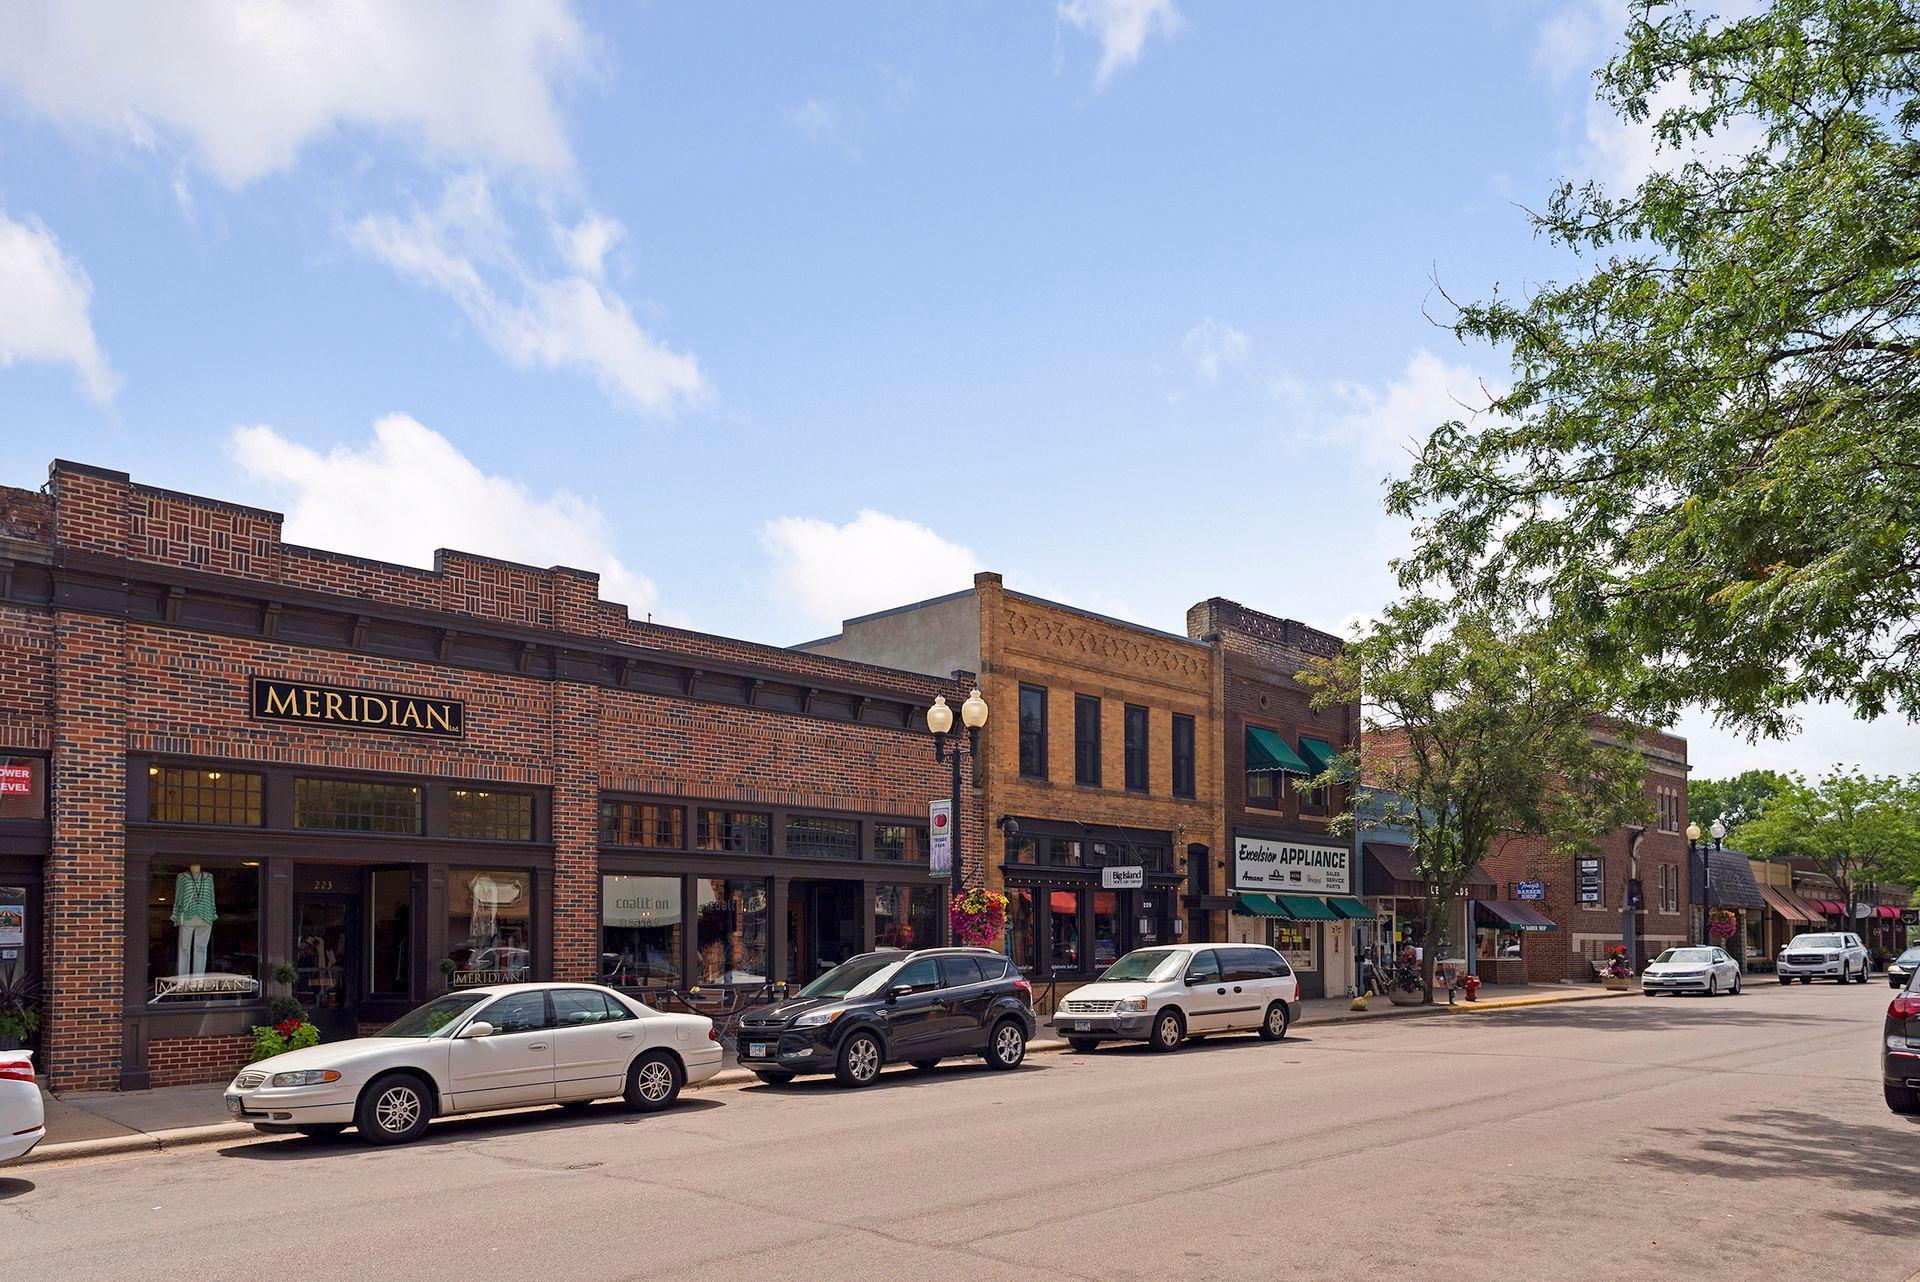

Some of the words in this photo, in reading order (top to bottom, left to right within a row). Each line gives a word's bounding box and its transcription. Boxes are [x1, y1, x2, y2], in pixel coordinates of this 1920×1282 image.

[264, 685, 450, 732] MERIDIAN
[1239, 844, 1277, 863] Excelsior
[1279, 847, 1346, 869] APPLIANCE
[314, 880, 333, 890] 223
